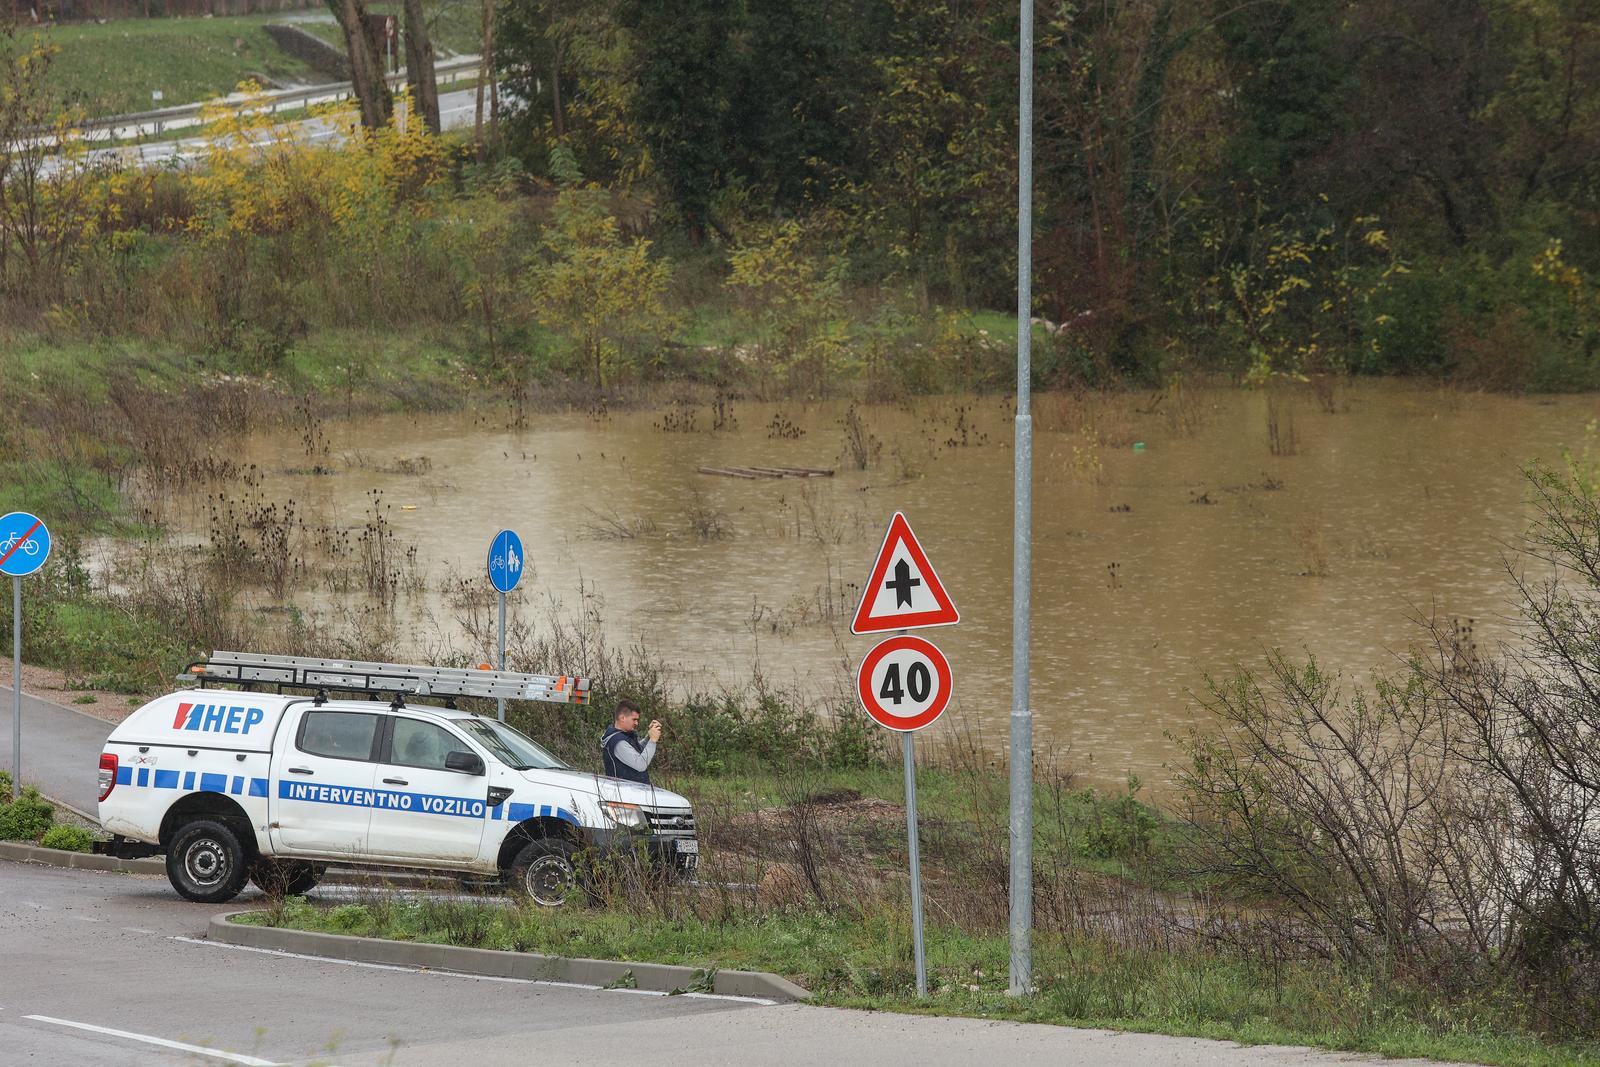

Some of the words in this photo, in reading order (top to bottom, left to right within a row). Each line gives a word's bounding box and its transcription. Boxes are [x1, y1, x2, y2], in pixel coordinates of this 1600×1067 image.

[880, 661, 931, 705] 40
[202, 704, 264, 735] HEP
[289, 784, 411, 809] INTERVENTNO
[422, 797, 483, 816] VOZILO
